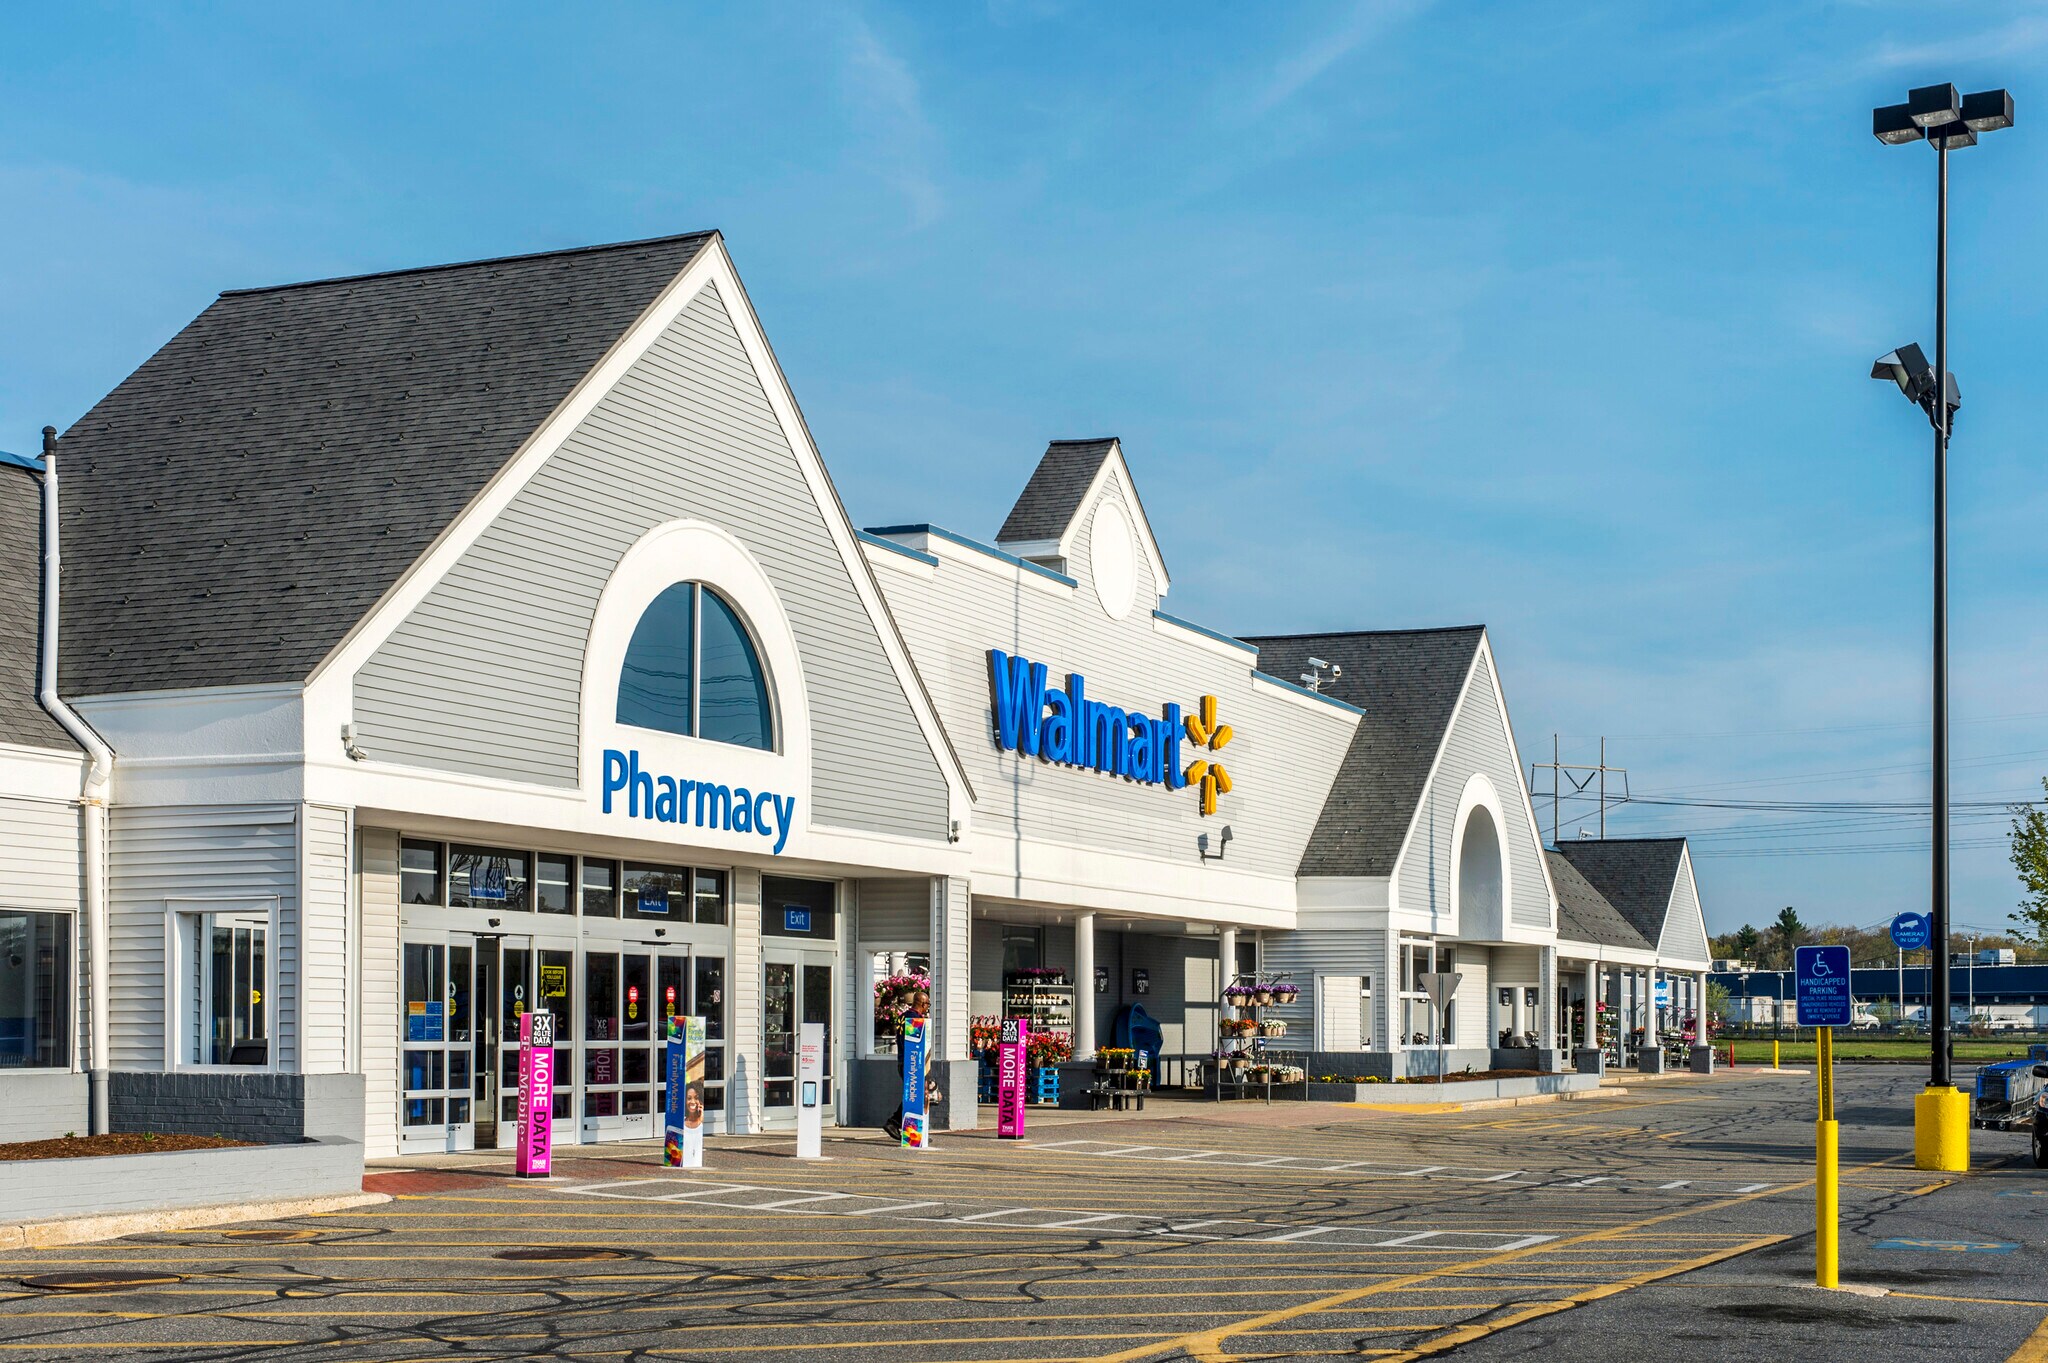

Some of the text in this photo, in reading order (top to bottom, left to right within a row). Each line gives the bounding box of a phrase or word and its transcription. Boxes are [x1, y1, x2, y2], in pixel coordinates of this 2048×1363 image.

[986, 649, 1186, 791] Walmart
[603, 749, 795, 856] Pharmacy
[790, 911, 805, 925] Exit
[1800, 977, 1846, 986] HANDICAPPED
[1809, 986, 1838, 995] PARKING
[534, 1016, 551, 1031] 3X
[1003, 1020, 1018, 1032] 3X
[533, 1053, 549, 1107] MORE
[1002, 1048, 1016, 1088] MORE
[1002, 1090, 1015, 1124] DATA
[532, 1111, 547, 1157] DATA
